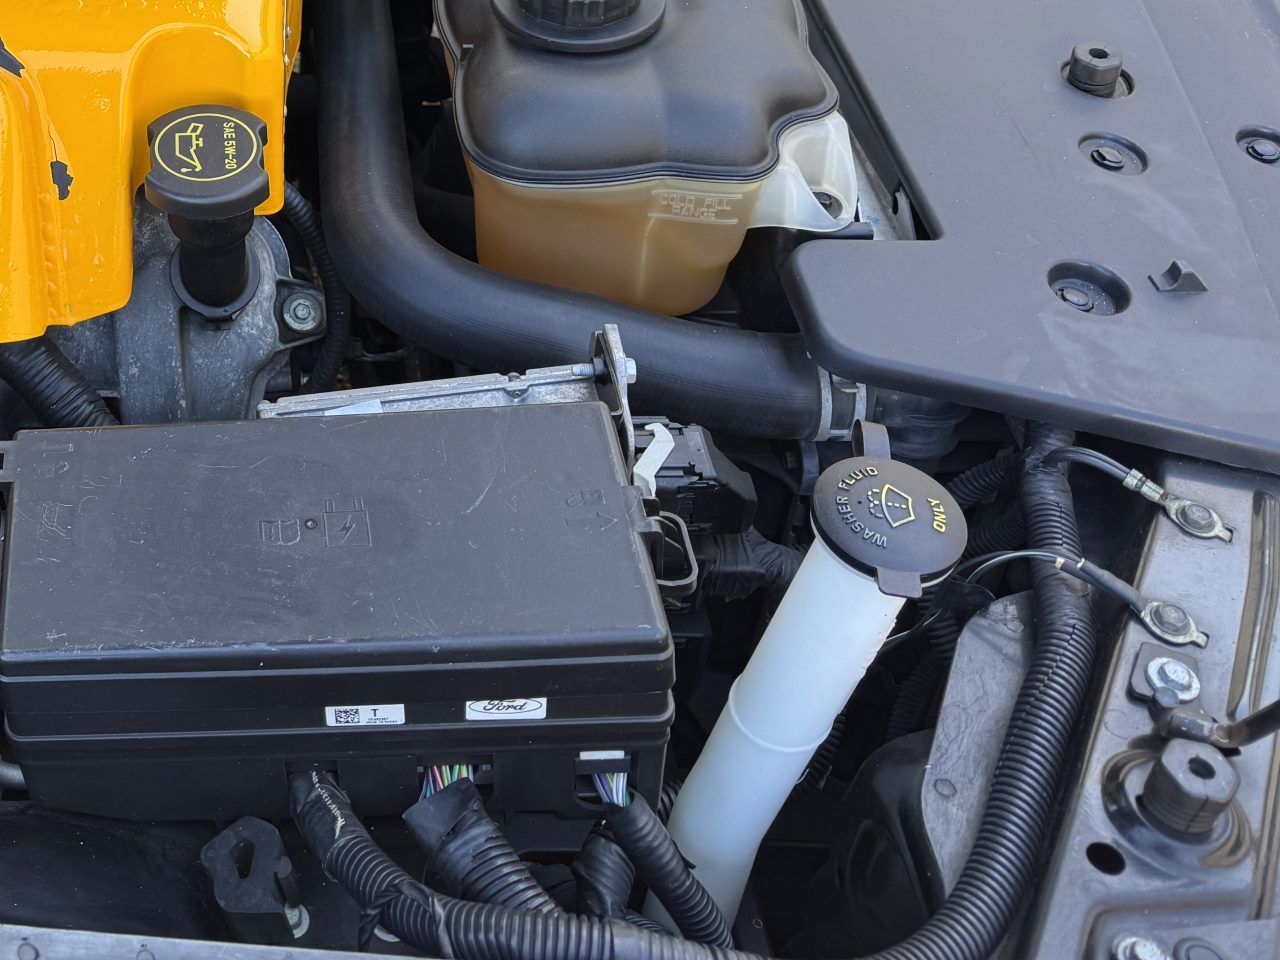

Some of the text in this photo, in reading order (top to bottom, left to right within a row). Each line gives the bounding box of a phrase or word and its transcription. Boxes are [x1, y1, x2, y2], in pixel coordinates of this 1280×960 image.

[223, 121, 238, 170] SAE 5W-20
[660, 193, 732, 211] COLD FILL
[671, 206, 718, 220] RANGE
[836, 466, 888, 548] WASHER FLUID
[927, 497, 947, 533] ONLY
[370, 708, 379, 717] T
[482, 699, 527, 712] Ford
